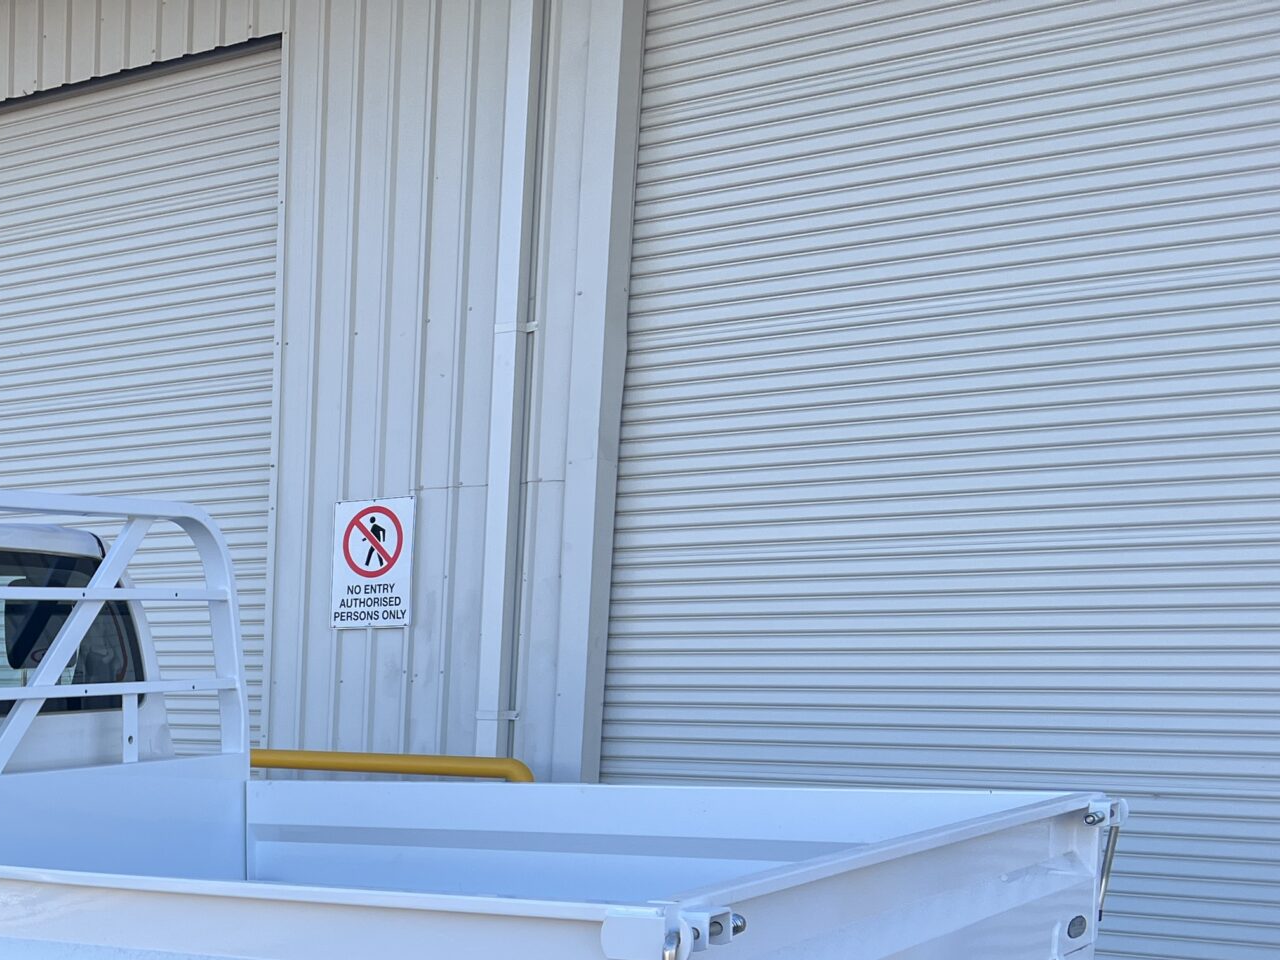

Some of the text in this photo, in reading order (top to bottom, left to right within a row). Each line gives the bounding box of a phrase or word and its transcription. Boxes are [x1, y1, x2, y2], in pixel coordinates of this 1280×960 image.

[347, 583, 396, 595] NO ENTRY
[339, 596, 401, 609] AUTHORISED
[333, 609, 407, 622] PERSONS ONLY
